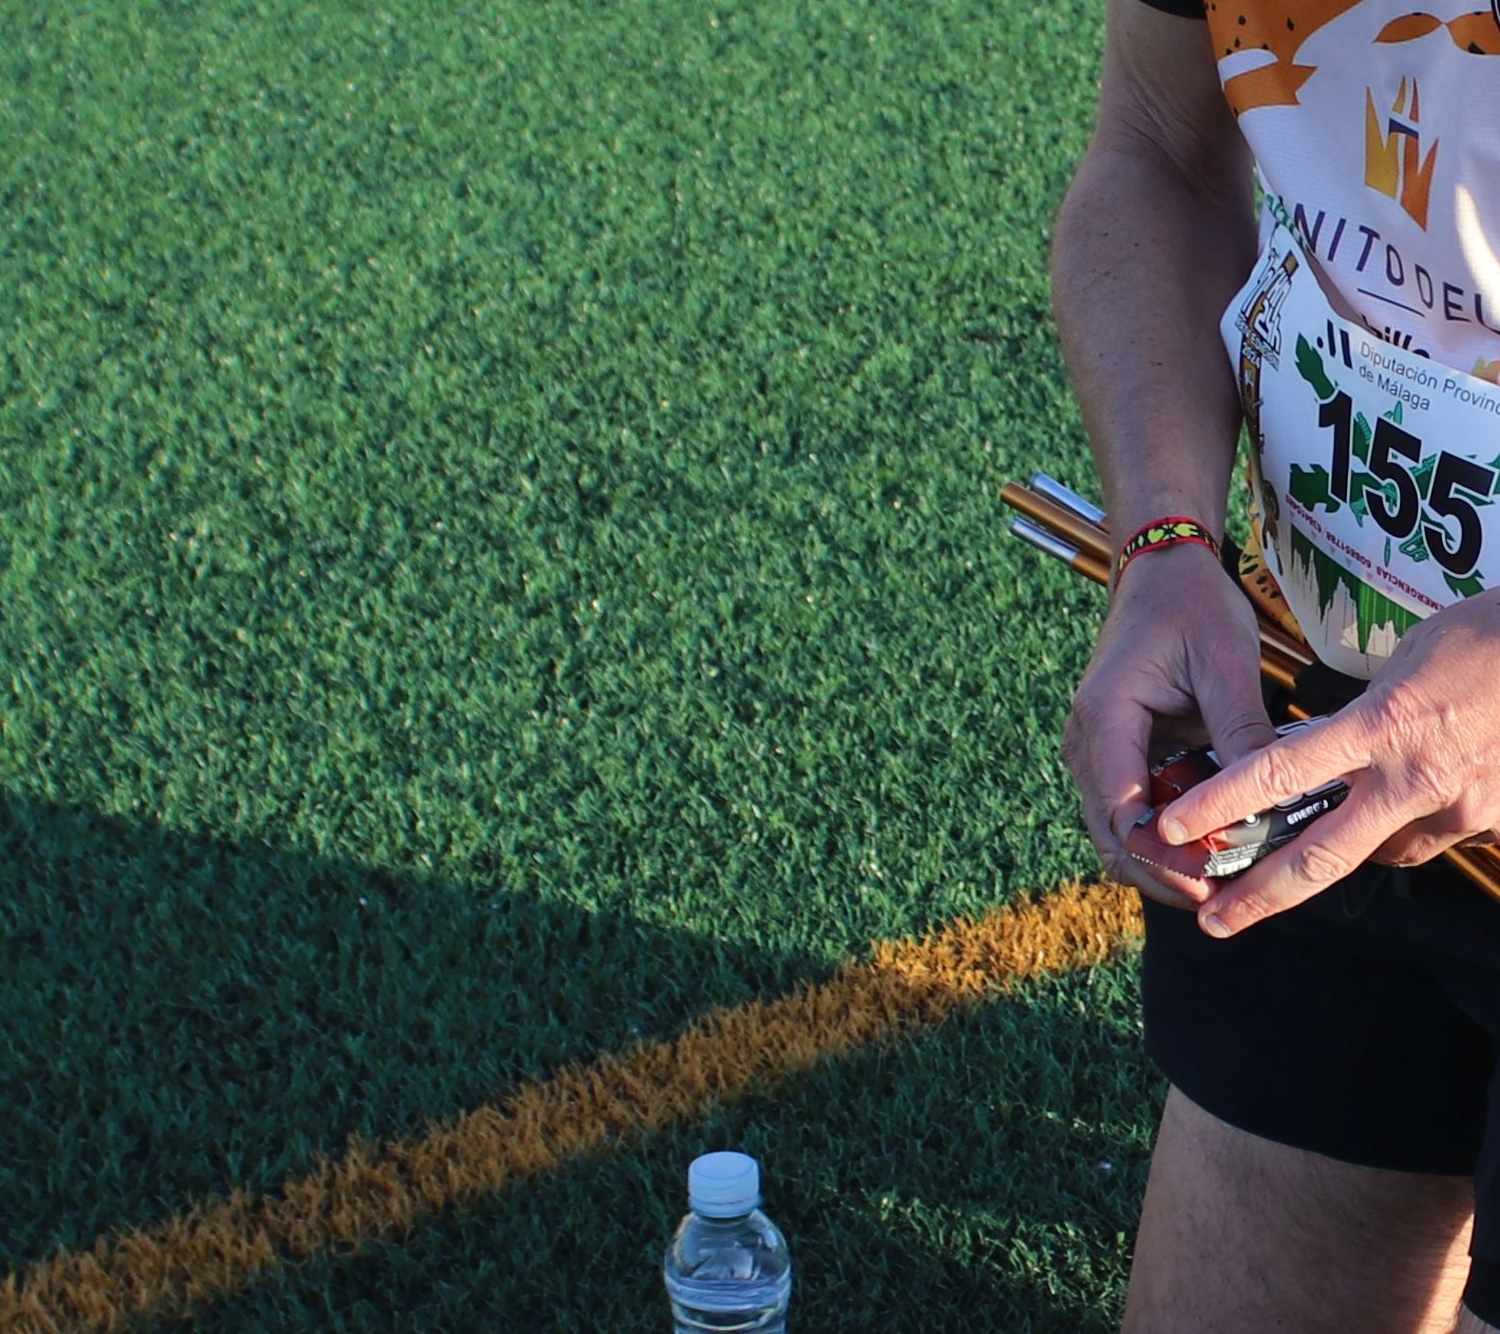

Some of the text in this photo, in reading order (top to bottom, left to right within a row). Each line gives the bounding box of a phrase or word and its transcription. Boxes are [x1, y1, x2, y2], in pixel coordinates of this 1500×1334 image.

[1294, 203, 1404, 287] NITO
[1359, 364, 1431, 411] de Málaga
[1360, 341, 1438, 390] Diputación
[1319, 390, 1496, 576] 155
